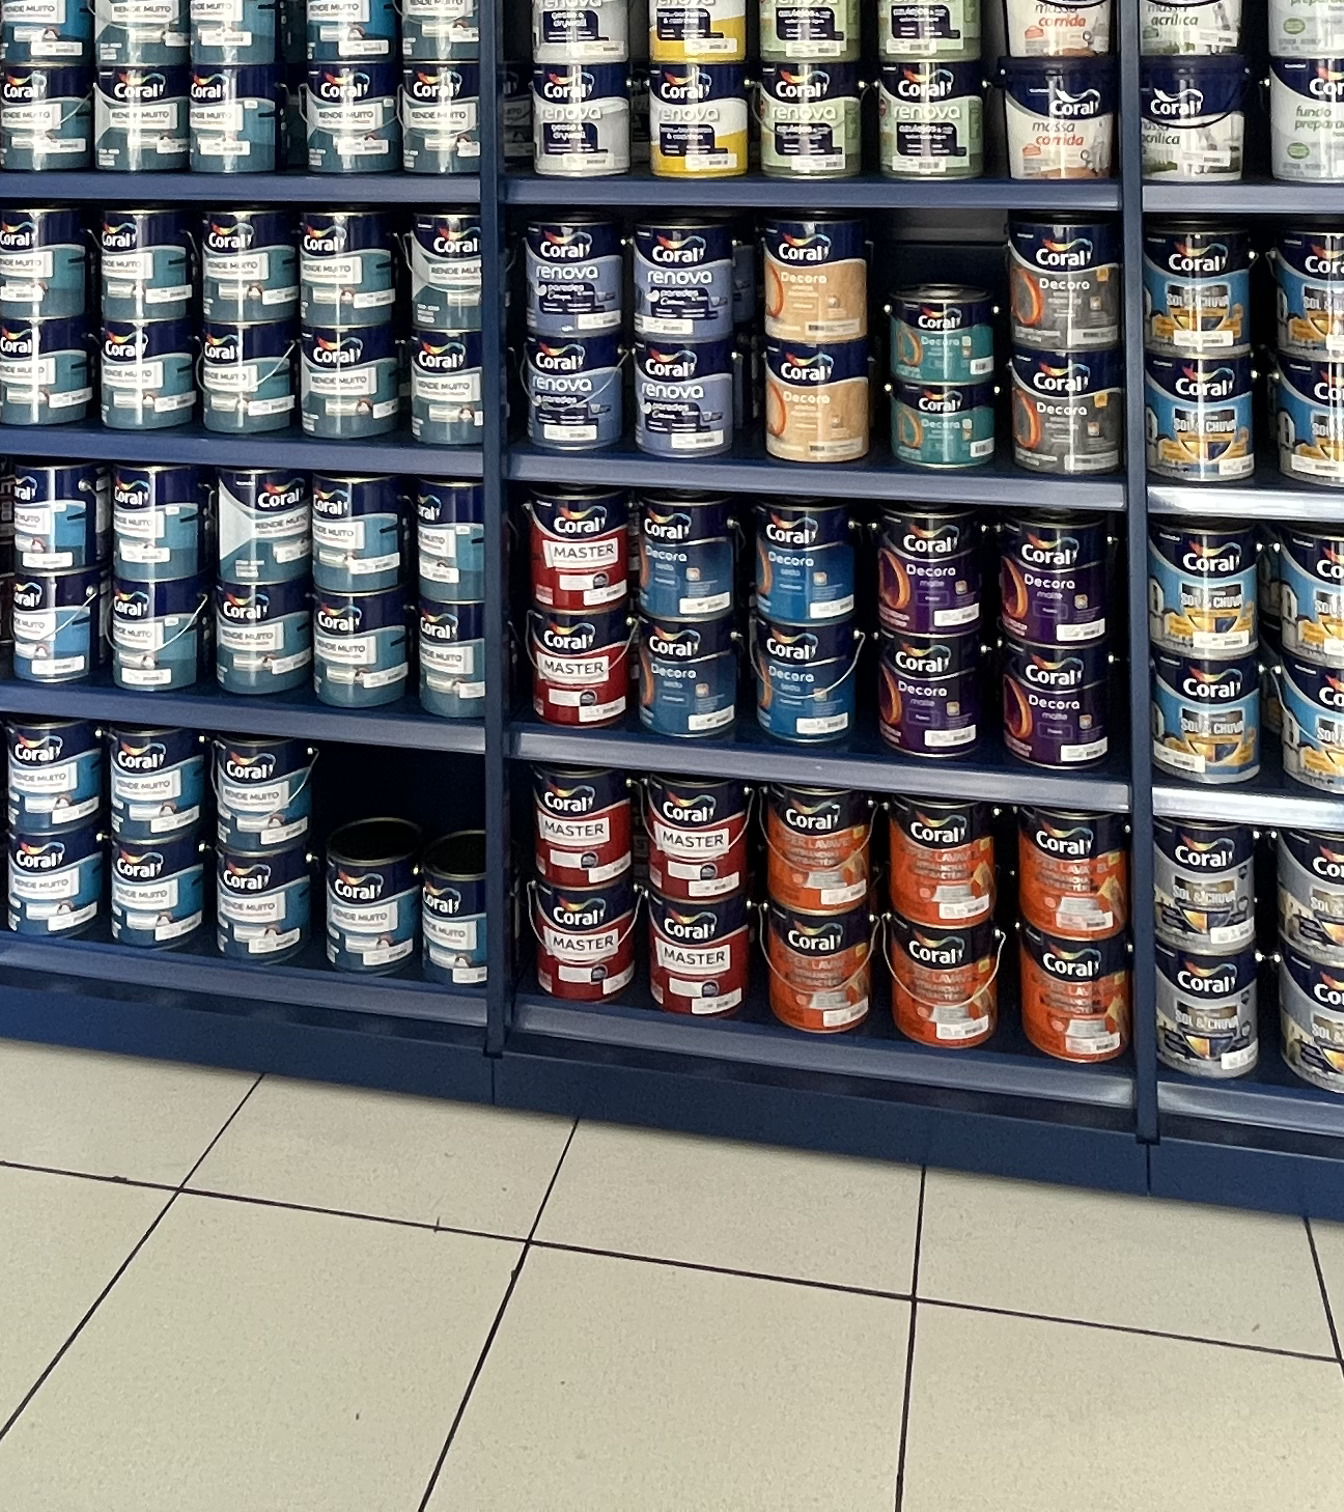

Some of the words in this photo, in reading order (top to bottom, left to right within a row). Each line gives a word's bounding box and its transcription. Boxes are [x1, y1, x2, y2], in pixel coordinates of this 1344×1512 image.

[1040, 16, 1086, 27] corrida
[321, 82, 363, 97] Coral
[898, 80, 945, 96] Coral
[772, 105, 837, 120] renova
[894, 105, 960, 120] renova
[1050, 100, 1095, 115] Coral
[1036, 134, 1084, 147] corrida
[540, 242, 586, 259] Coral
[652, 246, 699, 262] Coral
[778, 244, 824, 260] Coral
[1036, 248, 1086, 265] Coral
[536, 264, 598, 280] renova
[646, 270, 712, 284] renova
[1040, 278, 1090, 291] Decora
[313, 348, 356, 364] Coral
[1034, 374, 1082, 390] Coral
[1036, 403, 1087, 416] Decora
[259, 490, 300, 508] Coral
[554, 516, 601, 533] Coral
[766, 524, 810, 543] Coral
[554, 542, 614, 559] MASTER
[904, 534, 952, 552] Coral
[1022, 546, 1070, 564] Coral
[1183, 553, 1235, 573] Coral
[906, 564, 956, 577] Decora
[1024, 576, 1075, 590] Decora
[544, 631, 588, 649] Coral
[544, 661, 604, 674] MASTER
[896, 653, 942, 672] Coral
[651, 666, 696, 679] Decora
[1026, 665, 1076, 684] Coral
[898, 682, 946, 696] Decora
[1028, 696, 1080, 710] Decora
[15, 745, 55, 761] Coral
[118, 751, 158, 769] Coral
[227, 761, 267, 778] Coral
[544, 792, 588, 811] Coral
[664, 802, 710, 822] Coral
[544, 822, 604, 836] MASTER
[663, 832, 724, 848] MASTER
[1036, 832, 1087, 854] Coral
[16, 850, 57, 867] Coral
[1175, 846, 1228, 866] Coral
[335, 882, 375, 899] Coral
[554, 907, 600, 926] Coral
[664, 949, 725, 964] MASTER
[909, 942, 958, 963] Coral
[1043, 954, 1094, 976] Coral
